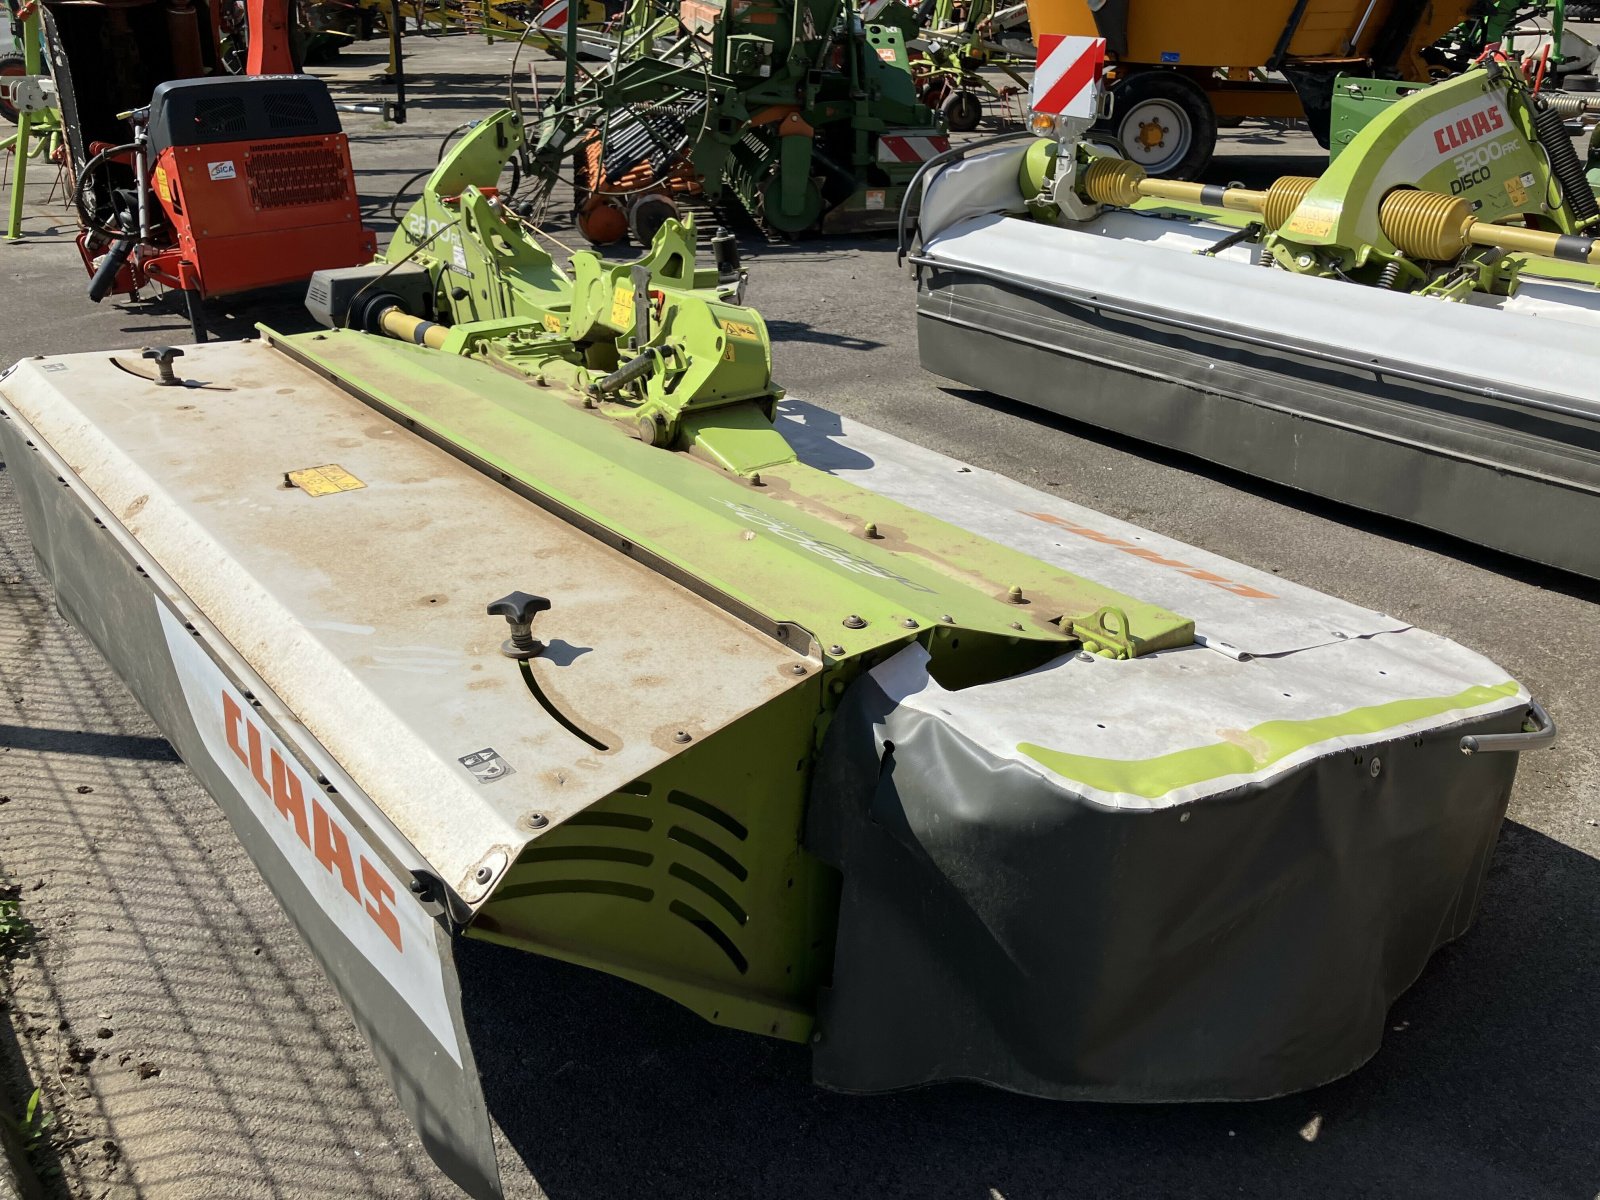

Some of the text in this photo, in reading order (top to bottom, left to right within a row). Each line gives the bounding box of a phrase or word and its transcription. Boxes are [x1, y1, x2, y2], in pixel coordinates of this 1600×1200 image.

[1434, 105, 1504, 154] CLAAS
[215, 165, 233, 174] SICA
[1450, 166, 1491, 195] DISCO
[221, 688, 403, 954] CLAAS
